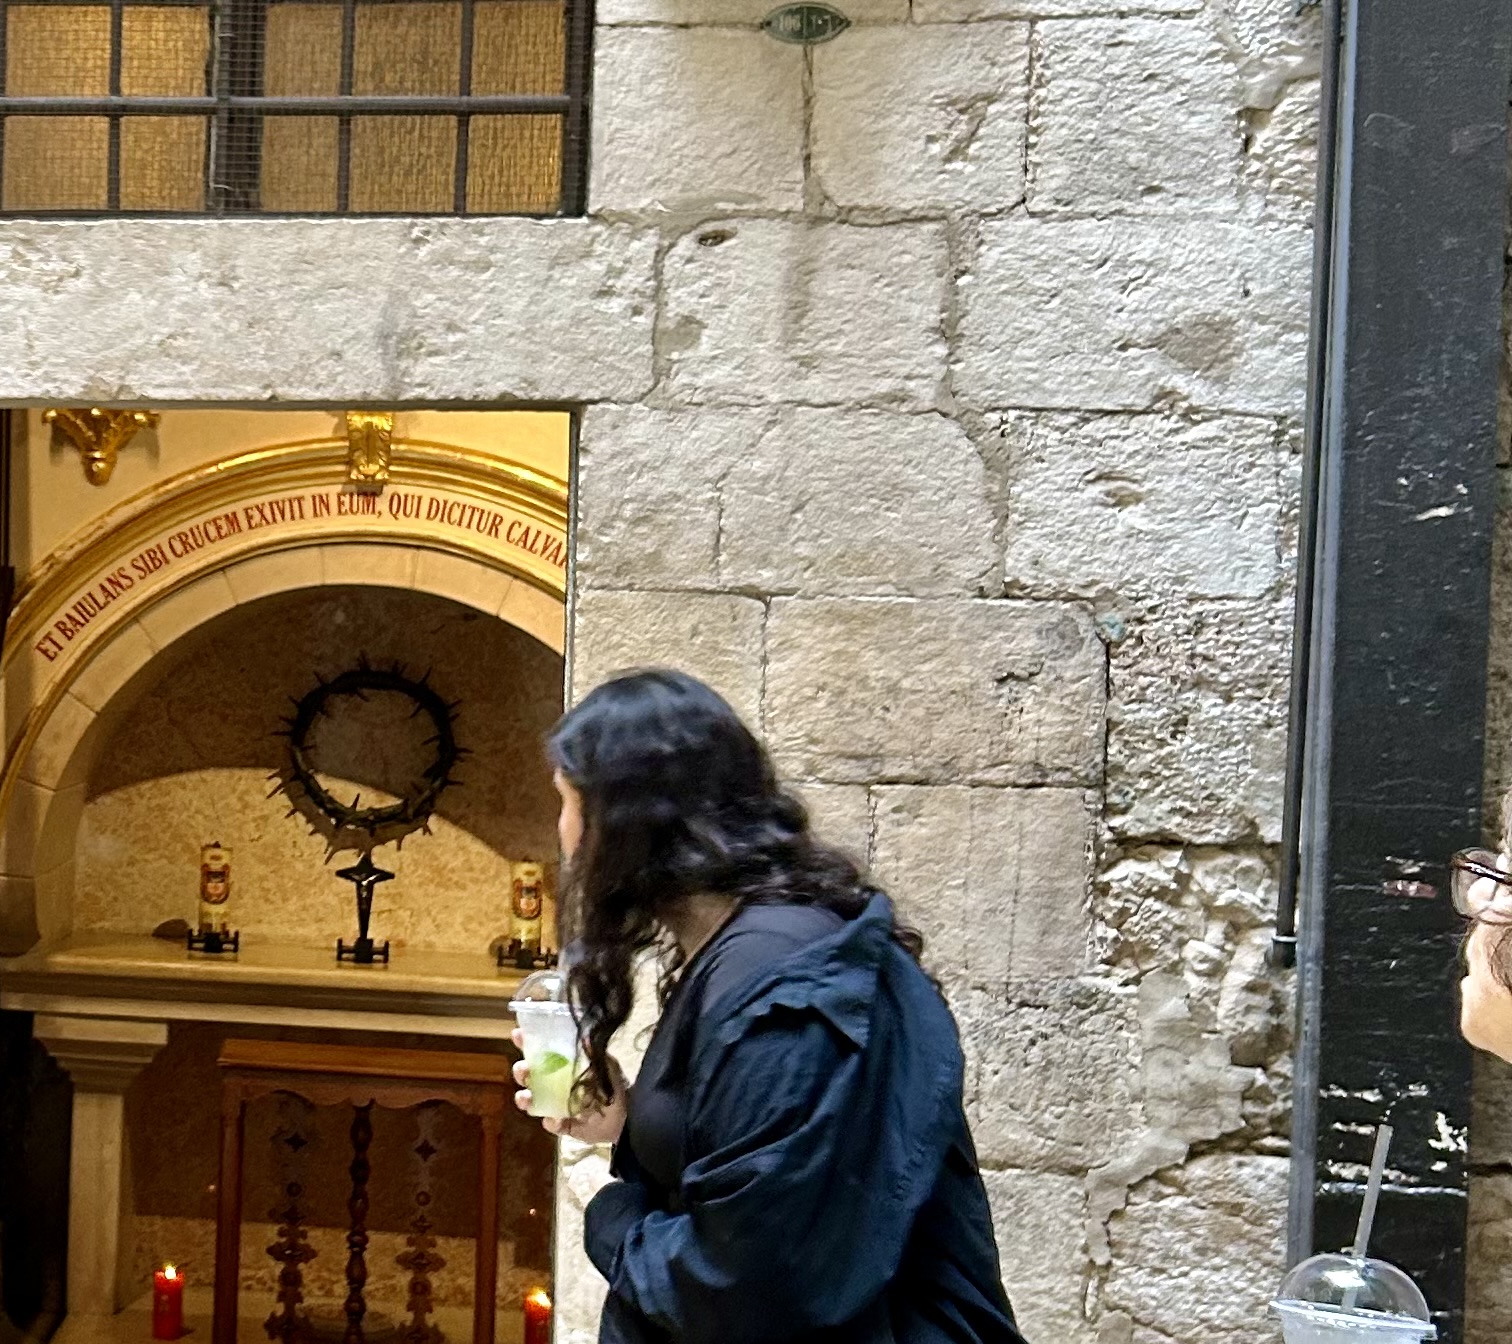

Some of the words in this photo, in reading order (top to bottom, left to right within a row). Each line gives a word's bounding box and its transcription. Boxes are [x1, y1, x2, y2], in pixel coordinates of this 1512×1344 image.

[35, 631, 64, 662] ET
[54, 567, 134, 641] BAIULANS
[131, 543, 170, 580] SIBI
[168, 511, 242, 558] CRUCEM
[243, 495, 305, 530] EXIVIT
[311, 493, 330, 518] IN
[337, 492, 382, 518] EUM,
[389, 491, 423, 520] QUI
[426, 497, 503, 539] DICITUR
